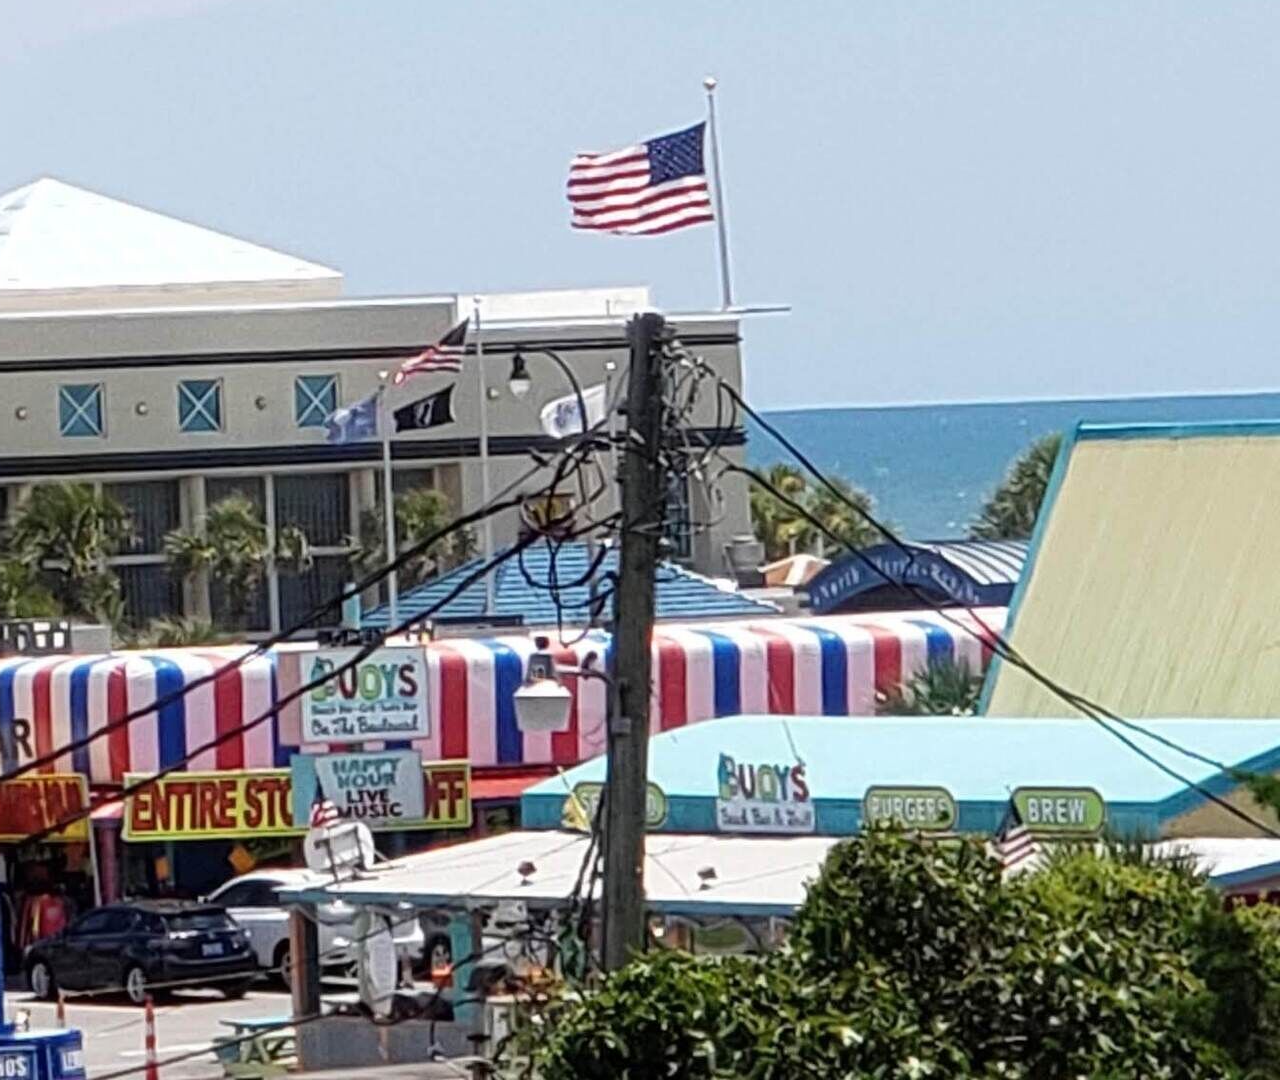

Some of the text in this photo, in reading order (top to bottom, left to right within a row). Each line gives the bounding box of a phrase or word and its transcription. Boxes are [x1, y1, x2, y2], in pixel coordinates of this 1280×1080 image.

[311, 657, 418, 701] BUOYS
[332, 757, 401, 774] HAPPY
[337, 772, 397, 789] HOUR
[719, 753, 810, 802] BUOYS
[131, 780, 237, 832] ENTIRE
[346, 788, 390, 804] LIVE
[337, 802, 402, 819] MUSIC
[1027, 796, 1086, 824] BREW
